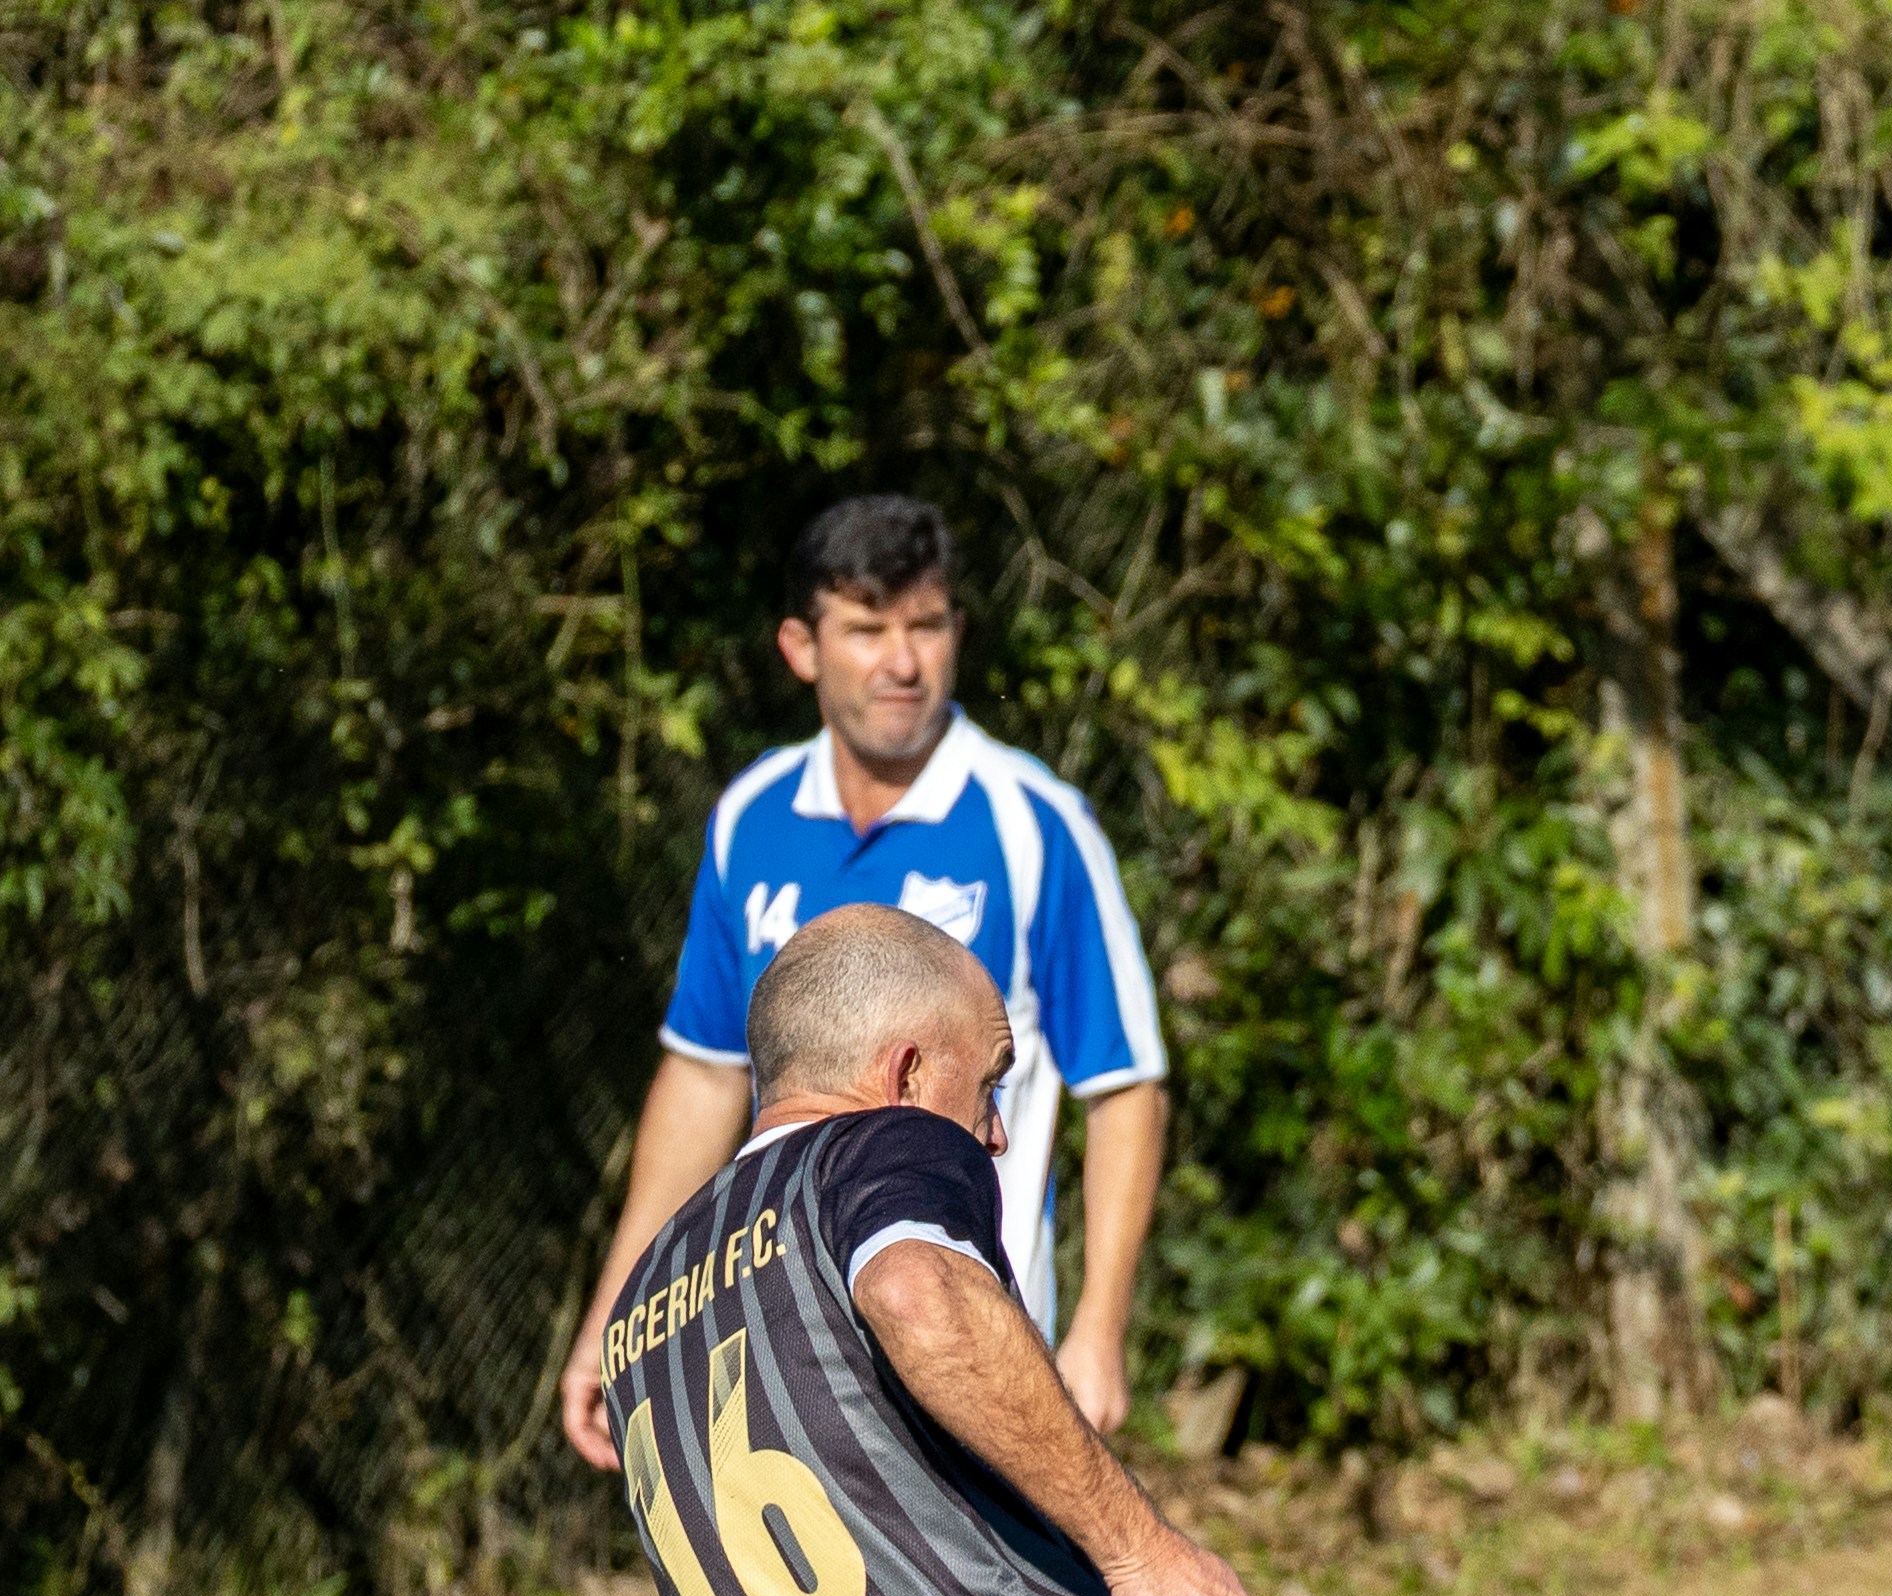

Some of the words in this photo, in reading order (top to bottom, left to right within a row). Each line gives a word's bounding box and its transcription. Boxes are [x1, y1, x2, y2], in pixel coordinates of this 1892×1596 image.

[745, 881, 801, 954] 14
[600, 1250, 716, 1397] ARCERIA
[724, 1208, 786, 1289] F.C.
